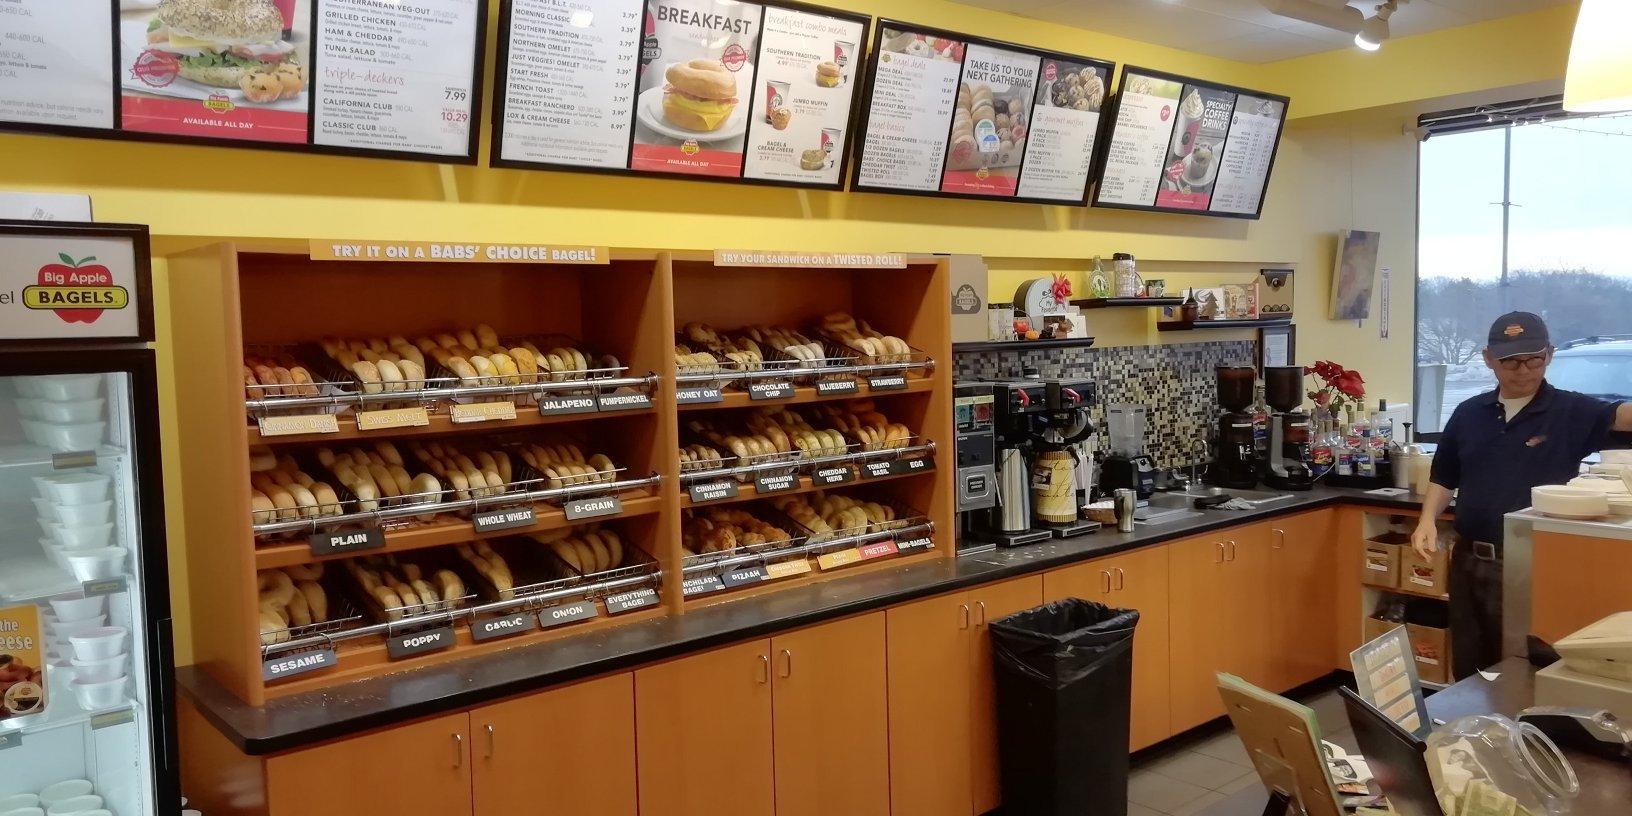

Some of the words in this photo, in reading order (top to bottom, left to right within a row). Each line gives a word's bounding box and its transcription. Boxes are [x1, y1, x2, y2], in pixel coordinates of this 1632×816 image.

[18, 8, 32, 16] CAL
[397, 5, 430, 15] VEG-OUT
[515, 9, 545, 19] MORNING
[546, 13, 571, 22] CLASSIC
[325, 12, 359, 21] GRILLED
[361, 16, 396, 26] CHICKEN
[657, 5, 752, 36] BREAKFAST
[355, 32, 393, 42] CHEDDAR
[514, 24, 547, 34] SOUTHERN
[548, 29, 579, 39] TRADITION
[33, 35, 46, 44] CAL
[325, 44, 347, 52] TUNA
[513, 39, 546, 48] NORTHERN
[548, 44, 571, 53] OMELET
[766, 48, 794, 56] SOUTHERN
[795, 52, 821, 60] TRADITION
[556, 59, 580, 68] OMELET
[970, 60, 989, 70] TAKE
[990, 62, 1000, 73] US
[1002, 65, 1012, 74] TO
[1013, 67, 1033, 78] YOUR
[966, 70, 988, 81] NEXT
[990, 74, 1032, 88] GATHERING
[444, 91, 466, 101] 7.99
[323, 98, 371, 109] CALIFORNIA
[373, 102, 393, 110] CLUB
[508, 98, 542, 107] BREAKFAST
[543, 102, 575, 110] RANCHERO
[1206, 100, 1232, 111] SPECIALTY
[440, 112, 468, 122] 10.29
[1204, 109, 1230, 120] COFFEE
[183, 117, 222, 127] AVAILABLE
[224, 120, 236, 128] ALL
[323, 121, 354, 130] CLASSIC
[1202, 118, 1228, 130] DRINKS
[332, 244, 362, 257] TRY
[366, 245, 380, 258] IT
[385, 246, 410, 258] ON
[414, 247, 425, 258] A
[430, 244, 481, 259] BABS'
[486, 246, 547, 260] CHOICE
[552, 248, 596, 261] BAGEL!
[722, 253, 739, 263] TRY
[741, 254, 765, 264] YOUR
[766, 254, 810, 265] SANDWICH
[812, 256, 825, 265] ON
[827, 257, 832, 265] A
[834, 254, 872, 265] TWISTED
[875, 255, 901, 266] ROLL!
[44, 272, 65, 284] Big
[69, 273, 107, 284] Apple
[39, 291, 114, 304] BAGELS
[752, 383, 790, 392] CHOCOLATE
[819, 381, 855, 391] BLUEBERRY
[870, 378, 904, 387] STRAWBERRY
[600, 395, 649, 405] PUMPERNICKEL
[676, 391, 701, 400] HONEY
[704, 390, 718, 398] OAT
[543, 399, 593, 410] JALAPENO
[867, 462, 890, 471] TOMATO
[910, 460, 924, 469] EGG
[819, 468, 847, 477] CHEDDAR
[760, 476, 793, 485] CINNAMON
[768, 482, 790, 490] SUGAR
[696, 483, 731, 493] CINNAMON
[704, 490, 727, 499] RAISIN
[574, 501, 614, 514] 8-GRAIN
[477, 514, 505, 526] WHOLE
[506, 511, 532, 523] WHEAT
[331, 534, 368, 546] PLAIN
[864, 546, 891, 556] PRETZEL
[682, 576, 717, 588] NCHILADA
[607, 589, 656, 604] EVERYTHING
[552, 606, 584, 619] ONION
[0, 620, 18, 632] the
[485, 617, 523, 632] GARLIC
[0, 636, 33, 650] eese
[403, 633, 441, 648] POPPY
[270, 654, 326, 674] SESAME
